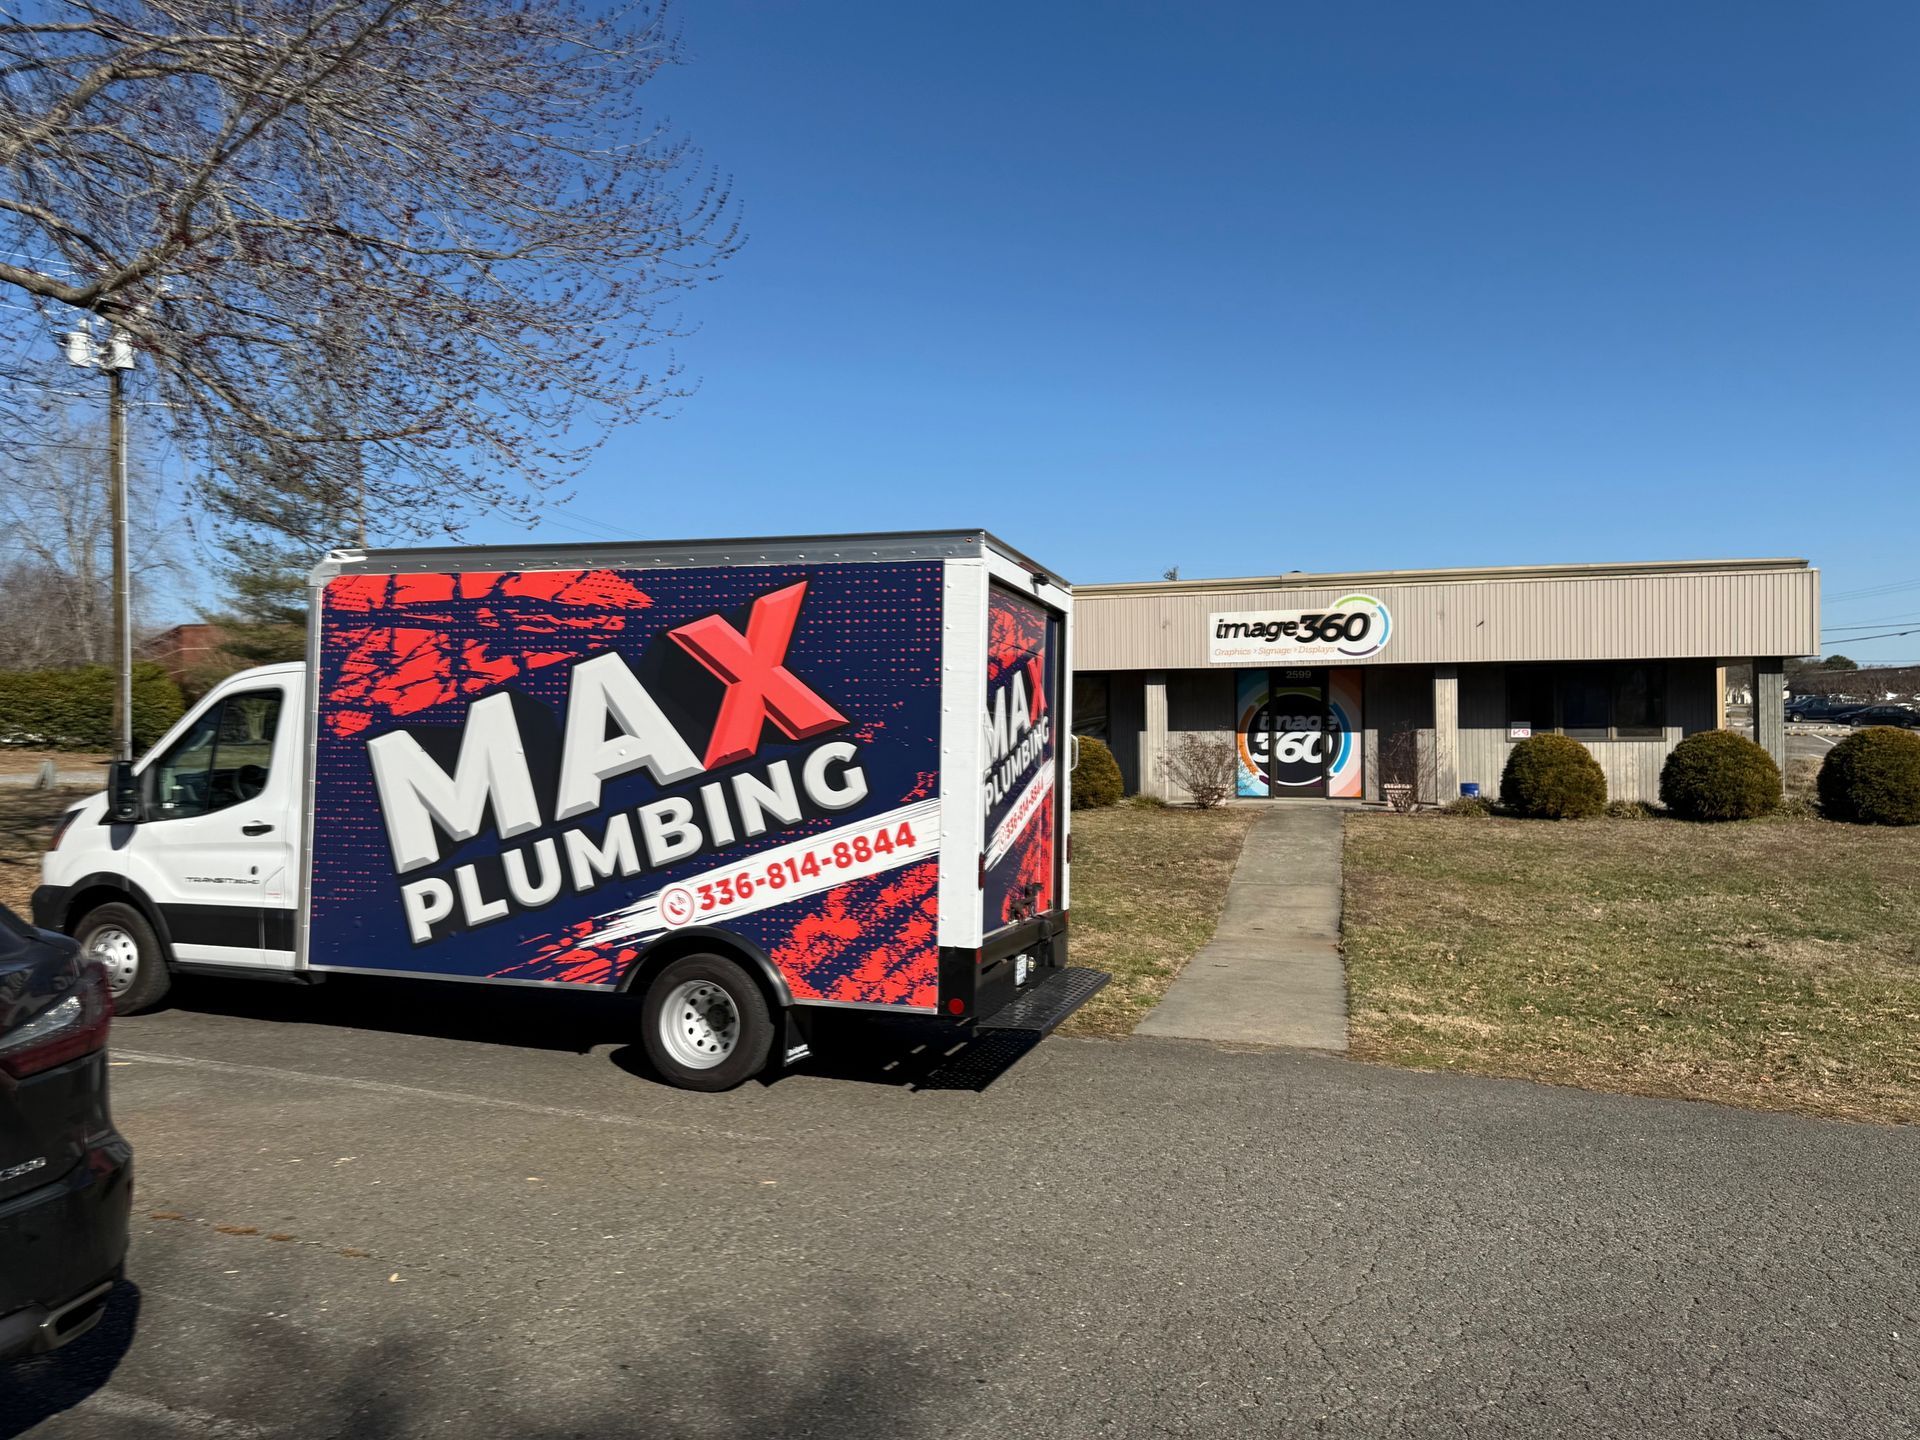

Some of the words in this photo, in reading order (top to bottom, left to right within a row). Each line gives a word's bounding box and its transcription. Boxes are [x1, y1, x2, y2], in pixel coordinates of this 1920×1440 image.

[1214, 648, 1252, 657] Graphics
[1258, 646, 1291, 656] Signage
[1297, 645, 1336, 655] Displays
[1216, 612, 1372, 643] image360
[983, 647, 1049, 775] MAX
[1285, 670, 1312, 679] 2599
[367, 580, 850, 875] MAX
[985, 716, 1050, 817] PLUMBING
[1251, 731, 1334, 764] 360
[401, 742, 869, 945] PLUMBING
[697, 822, 917, 911] 336-814-8844
